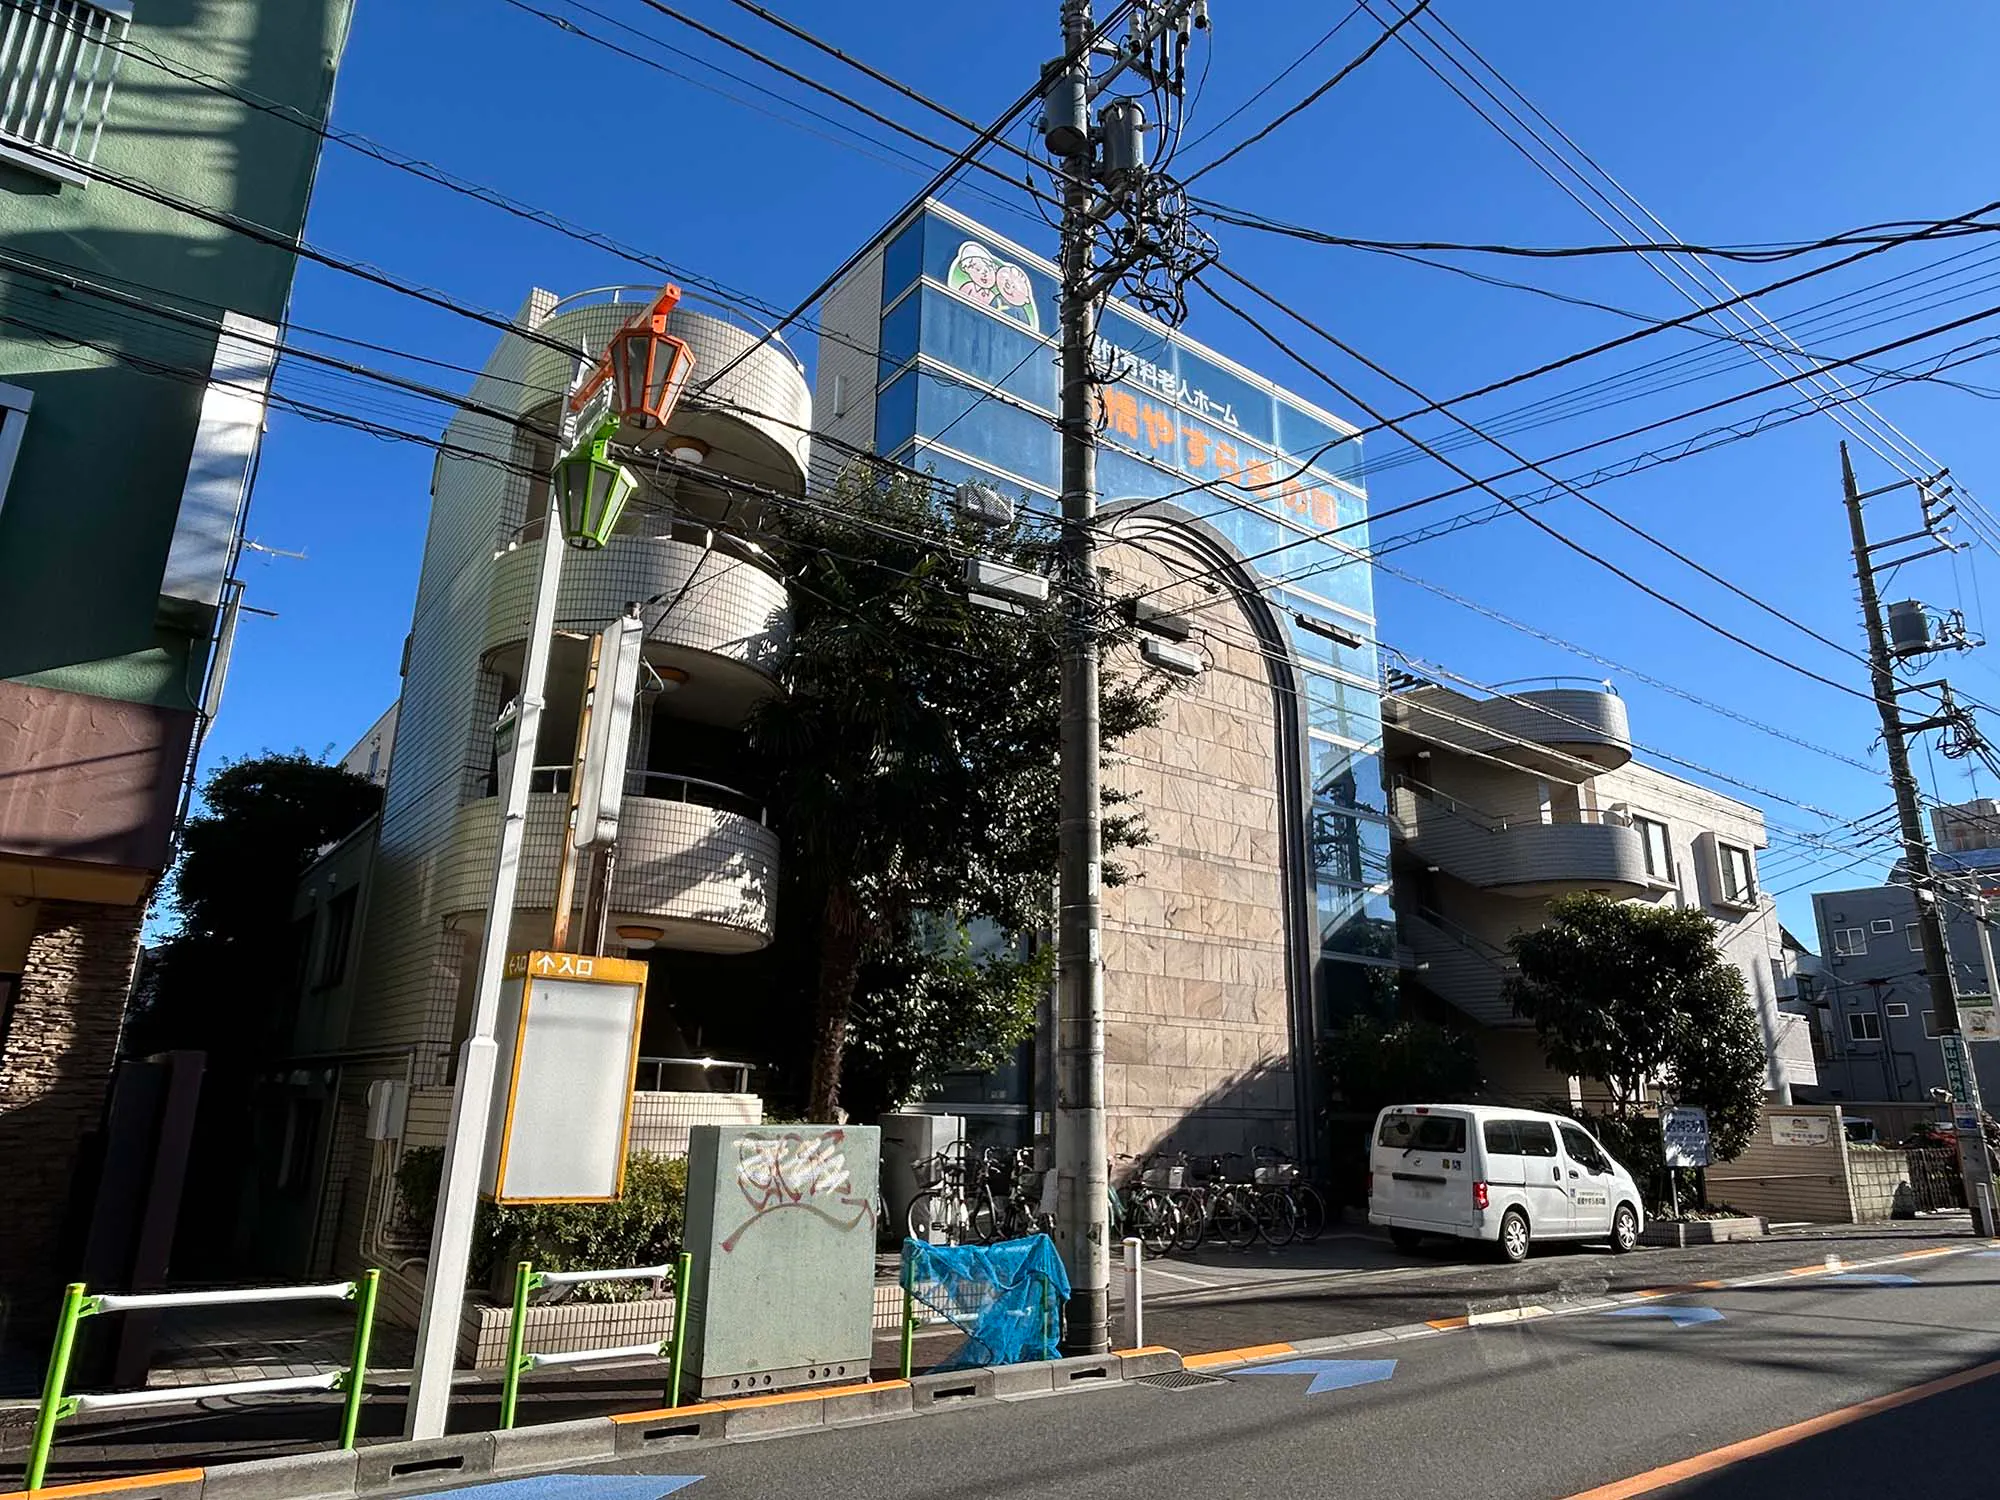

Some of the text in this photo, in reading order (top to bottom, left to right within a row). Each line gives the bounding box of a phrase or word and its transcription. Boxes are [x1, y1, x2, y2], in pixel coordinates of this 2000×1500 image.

[1094, 387, 1337, 529] 橋やすらぎの園
[558, 956, 593, 976] 入口
